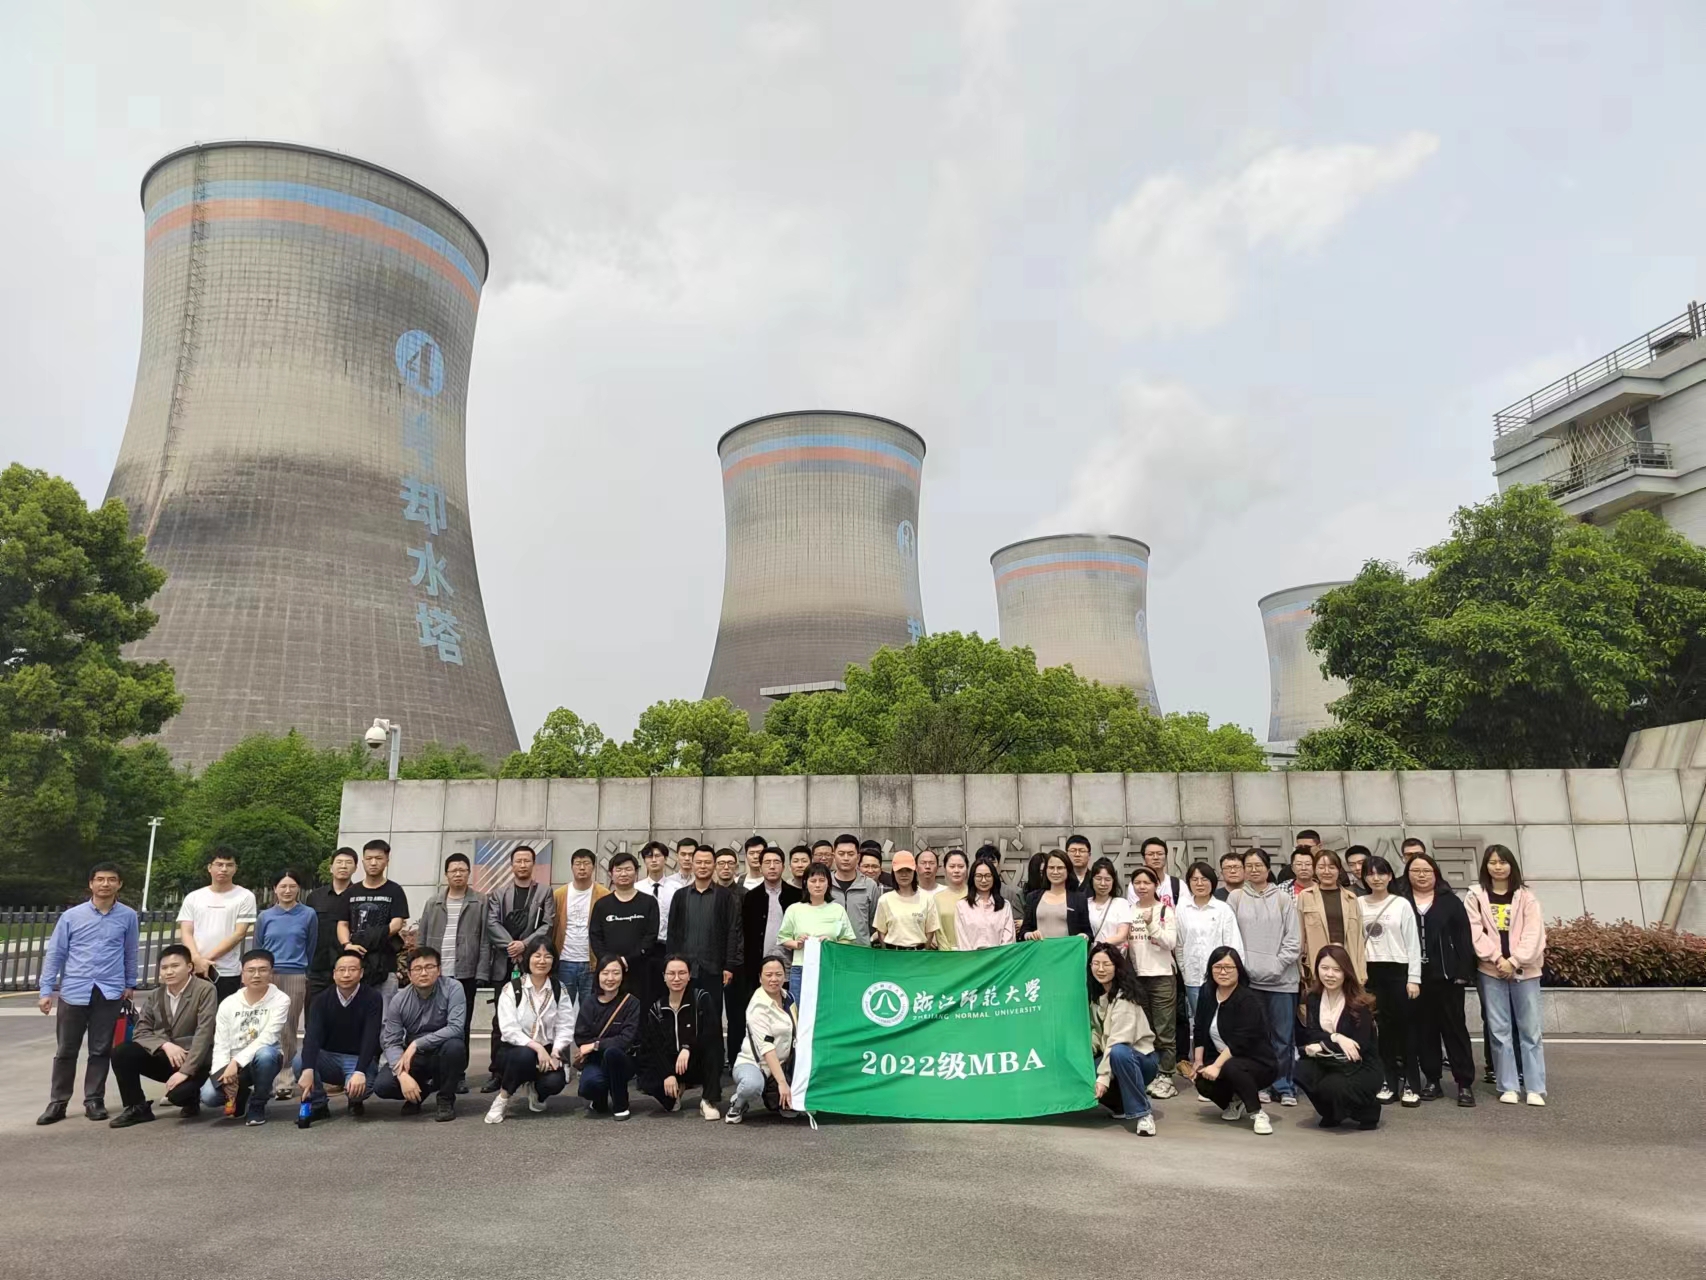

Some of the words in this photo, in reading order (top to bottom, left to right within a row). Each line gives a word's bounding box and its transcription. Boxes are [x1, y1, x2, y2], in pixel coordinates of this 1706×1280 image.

[399, 408, 464, 666] 却水塔
[235, 1008, 268, 1018] PERFECT
[912, 1013, 950, 1021] ZHEJIANG
[954, 1011, 990, 1020] NORMAL
[994, 1005, 1042, 1017] UNIVERSITY
[861, 1048, 1046, 1081] 2022级MBA
